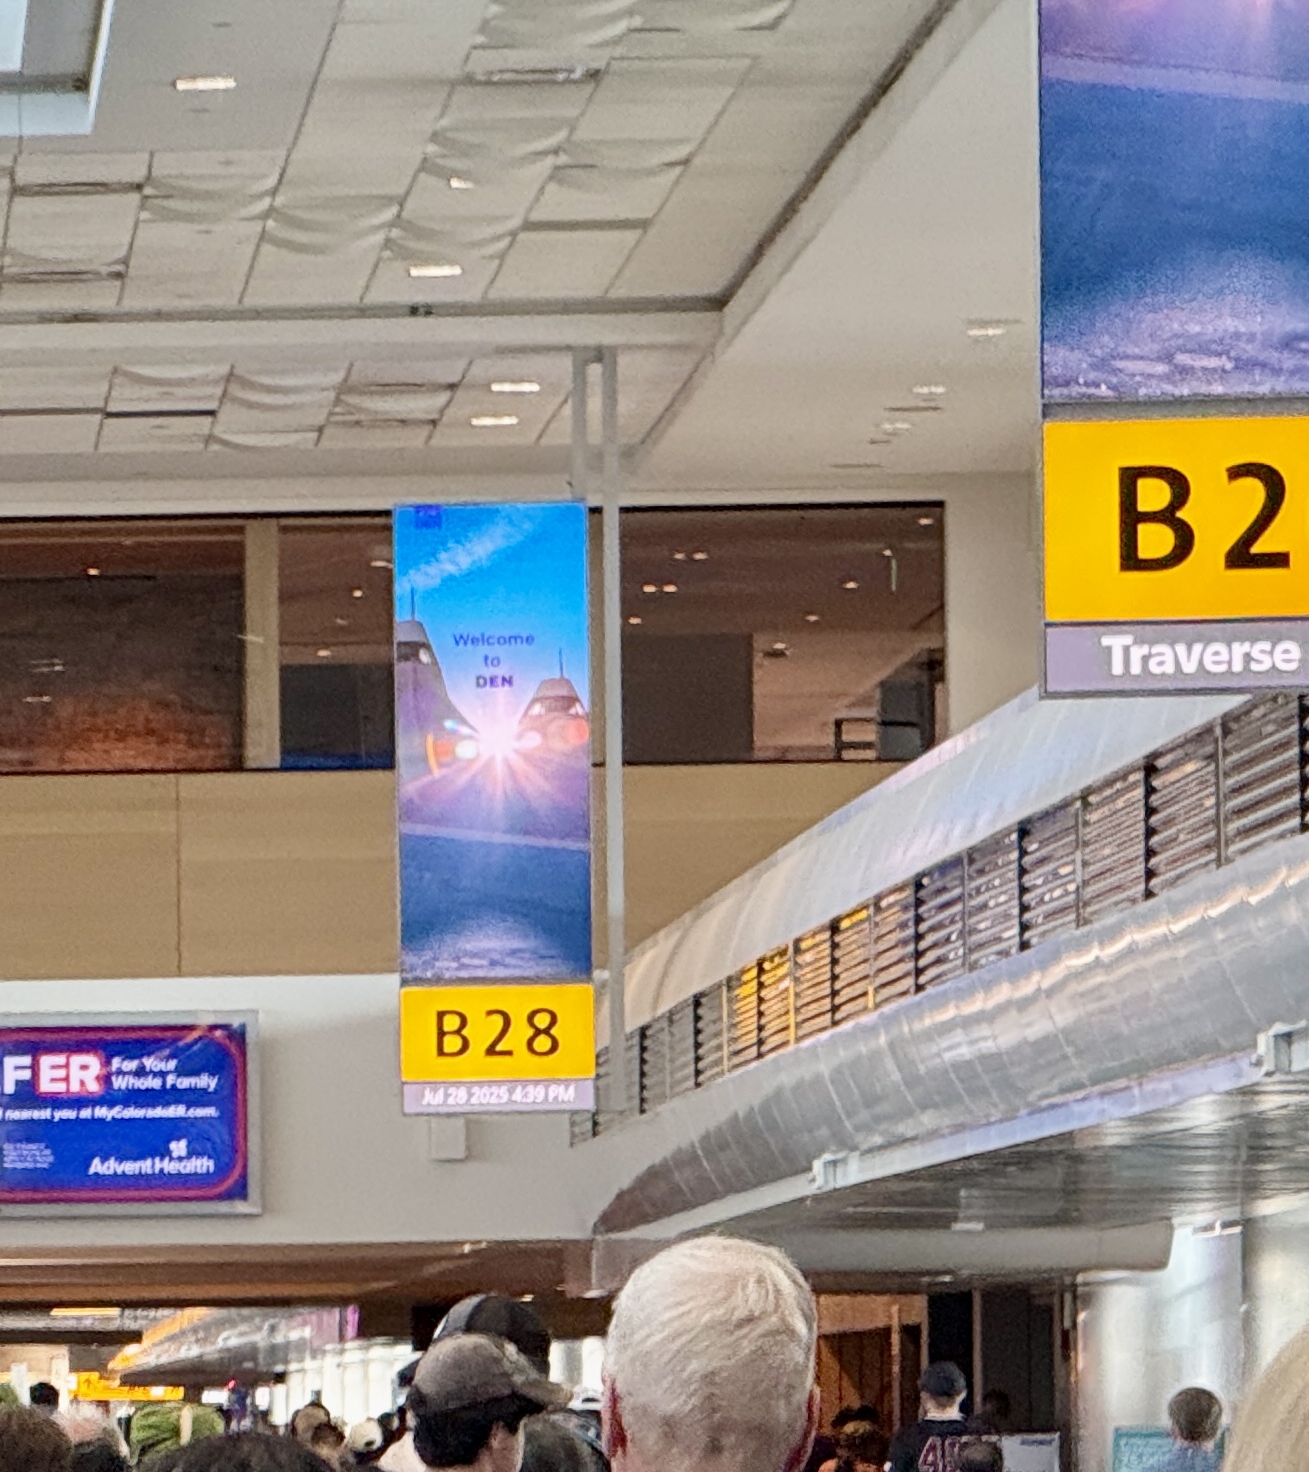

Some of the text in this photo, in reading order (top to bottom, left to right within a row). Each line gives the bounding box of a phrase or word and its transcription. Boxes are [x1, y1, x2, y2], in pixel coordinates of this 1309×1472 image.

[453, 632, 535, 647] Welcome
[484, 654, 501, 668] to
[1100, 634, 1301, 676] Traverse
[476, 675, 514, 688] DEN
[437, 1008, 560, 1057] B28
[111, 1055, 178, 1072] For Your
[111, 1073, 219, 1092] Whole Family
[422, 1087, 445, 1105] Jul
[470, 1085, 509, 1104] 2025
[548, 1084, 576, 1103] PM
[53, 1108, 77, 1122] you
[79, 1106, 92, 1119] at
